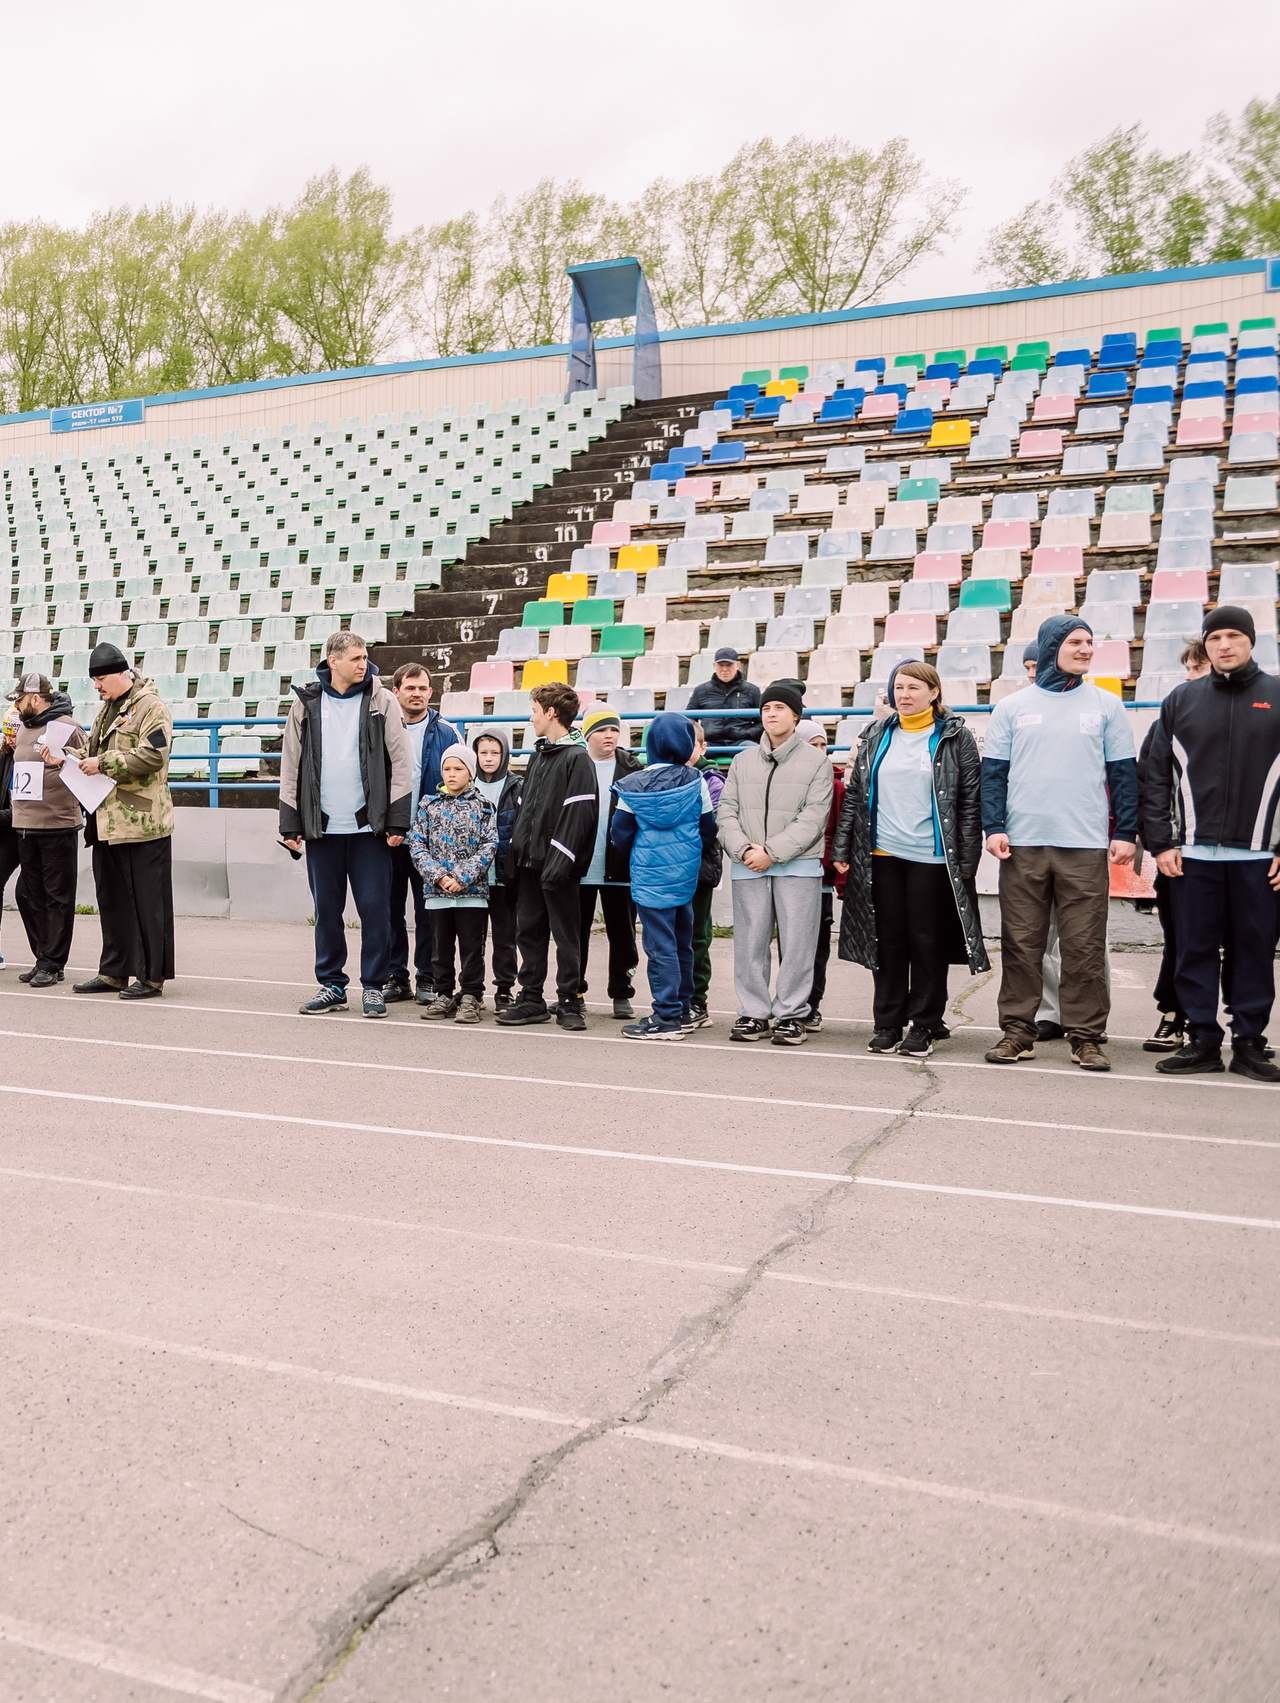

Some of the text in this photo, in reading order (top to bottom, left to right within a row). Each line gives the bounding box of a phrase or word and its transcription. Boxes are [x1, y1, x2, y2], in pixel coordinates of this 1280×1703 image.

[72, 407, 105, 419] СЕКТОР
[677, 407, 696, 418] 17
[661, 424, 680, 438] 16
[630, 455, 652, 469] 14
[593, 487, 613, 502] 12
[574, 508, 594, 521] 11
[554, 526, 577, 542] 10
[535, 547, 547, 562] 9
[486, 593, 499, 614] 7
[460, 620, 474, 642] 6
[437, 647, 452, 669] 5
[14, 772, 32, 794] 42
